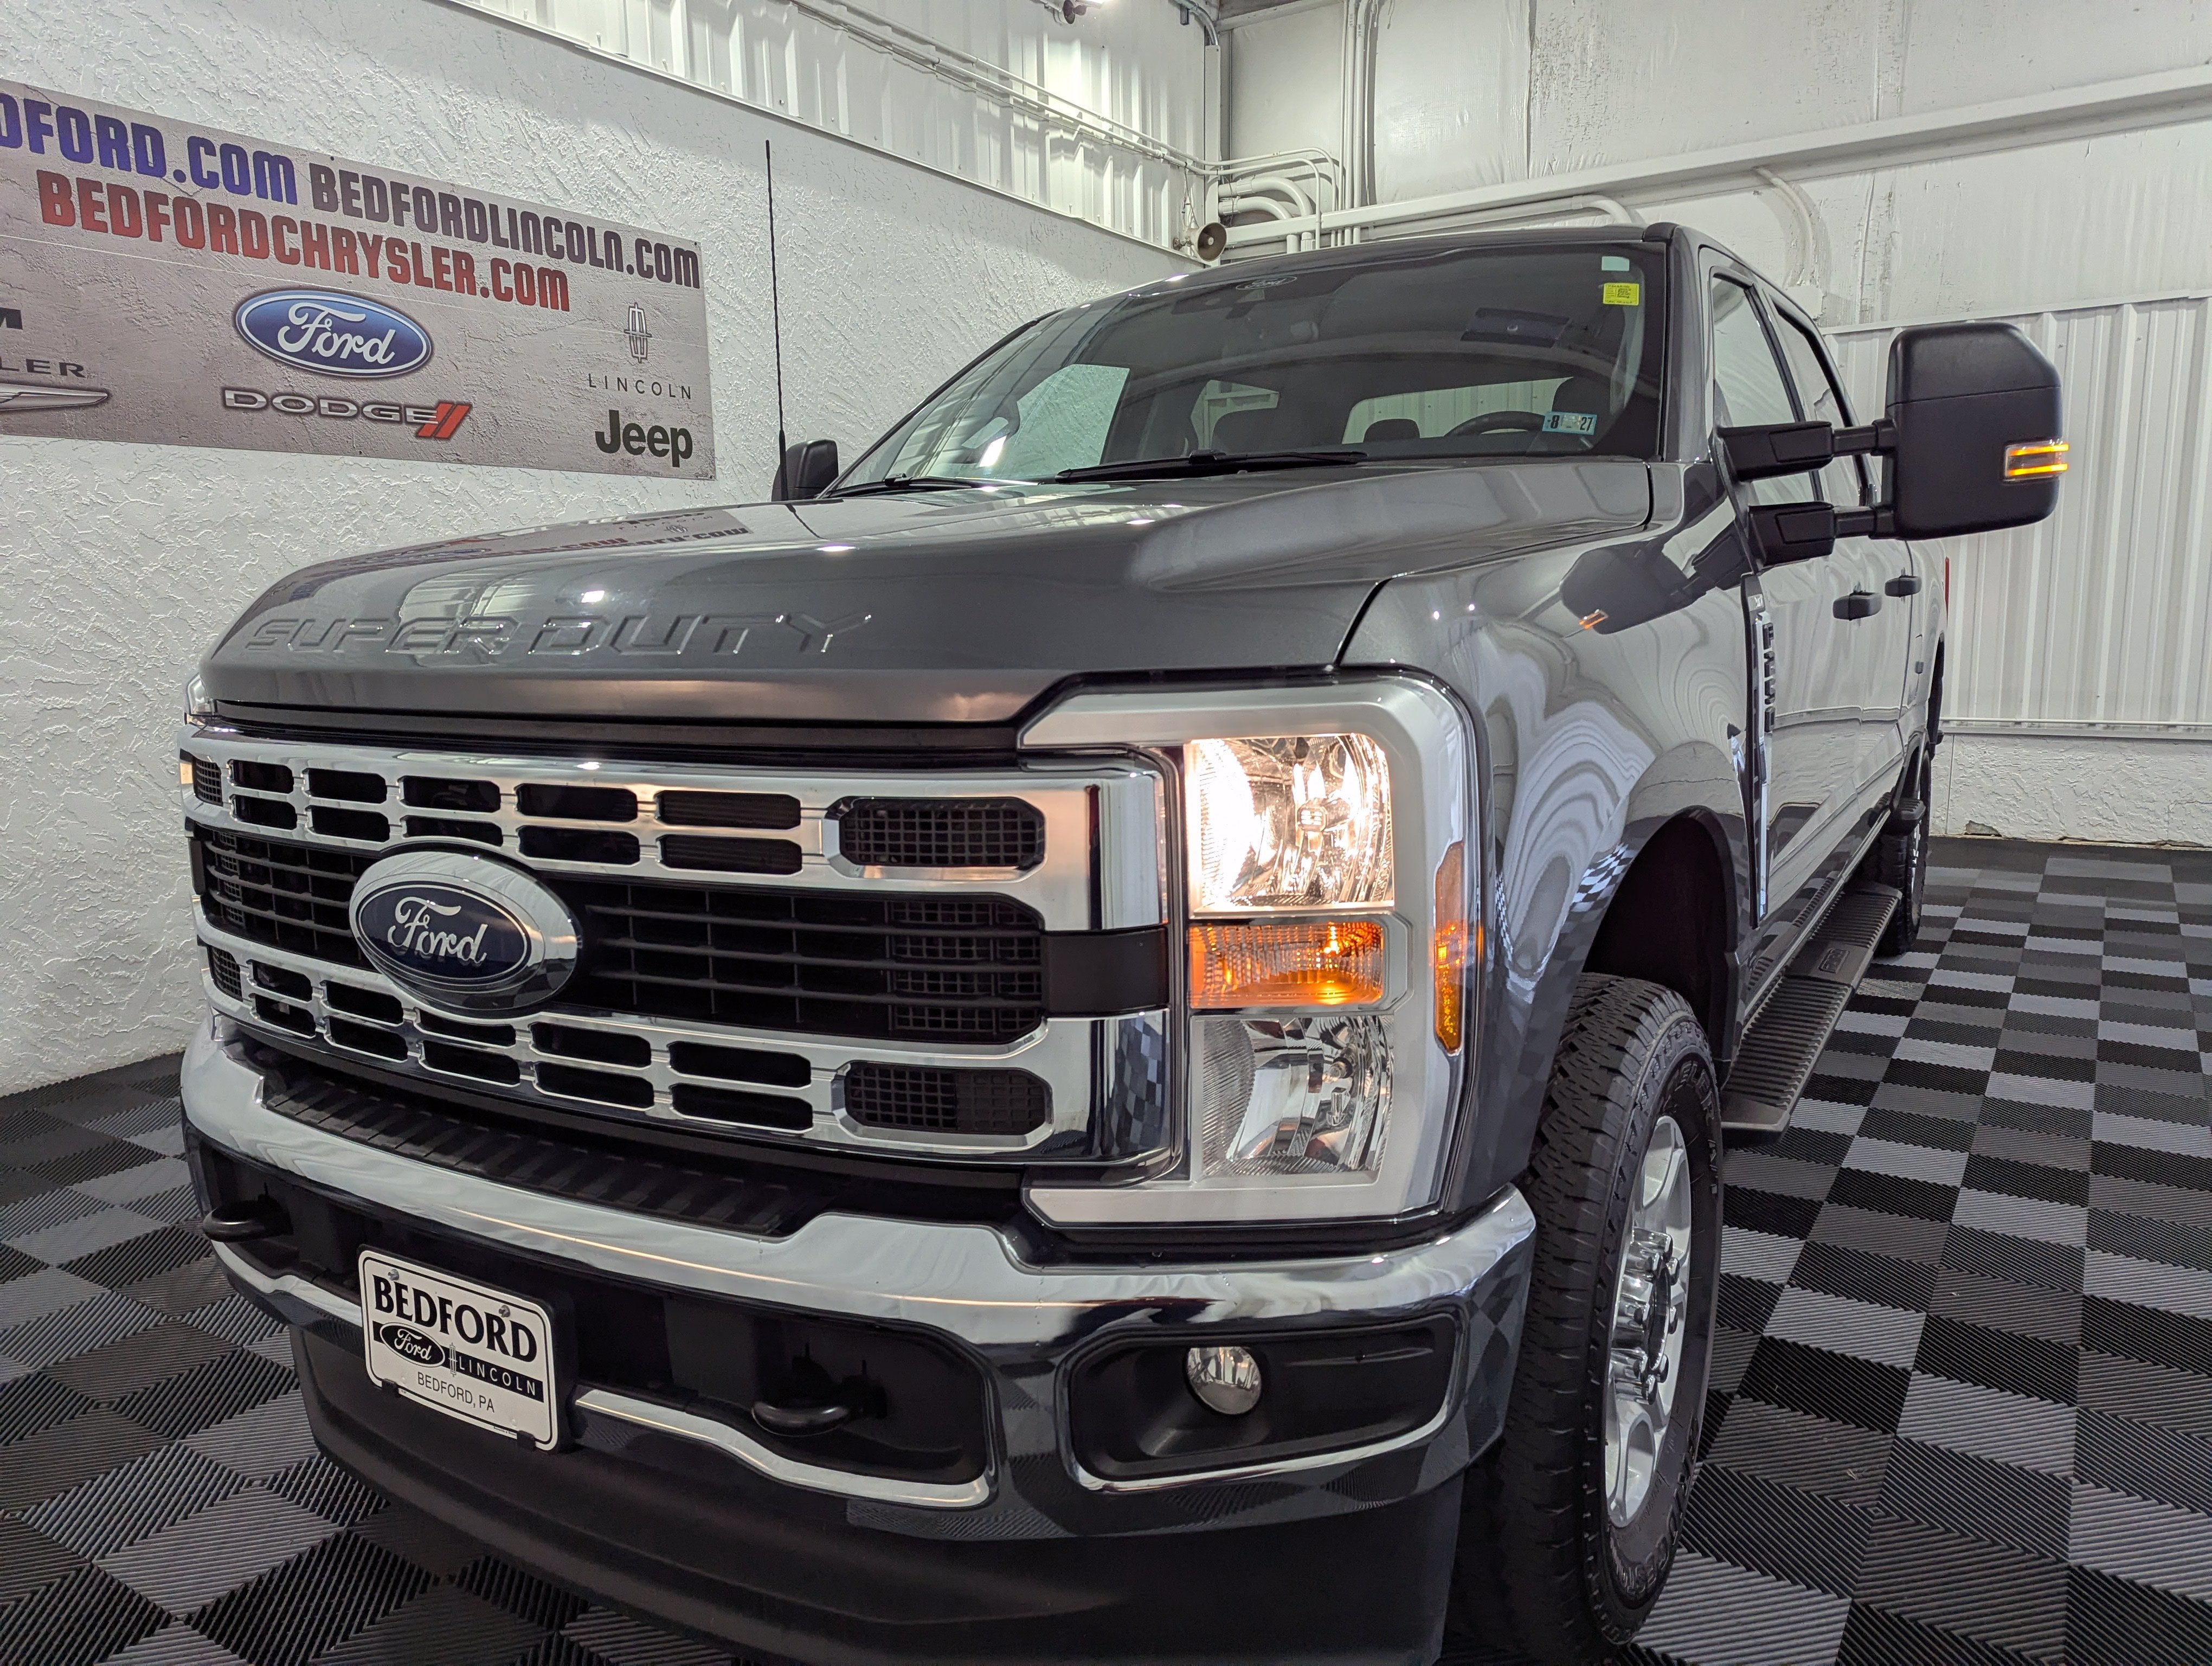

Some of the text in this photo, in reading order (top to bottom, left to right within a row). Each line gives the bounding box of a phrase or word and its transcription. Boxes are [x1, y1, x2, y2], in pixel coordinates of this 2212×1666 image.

[36, 169, 570, 312] BEDFORDCHRYSLER.COM
[309, 163, 700, 289] BEDFORDLINCOLN.COM
[278, 302, 395, 365] Ford
[224, 389, 439, 425] DODGE
[588, 373, 692, 400] LINCOLN
[595, 410, 693, 467] Jeep
[1551, 415, 1593, 432] 8 27
[245, 613, 871, 654] SUPER DUTY
[387, 896, 488, 964] Ford
[372, 1274, 537, 1363] BEDFORD
[394, 1328, 536, 1396] Ford LINCOLN
[417, 1372, 495, 1413] BEDFORD, PA
